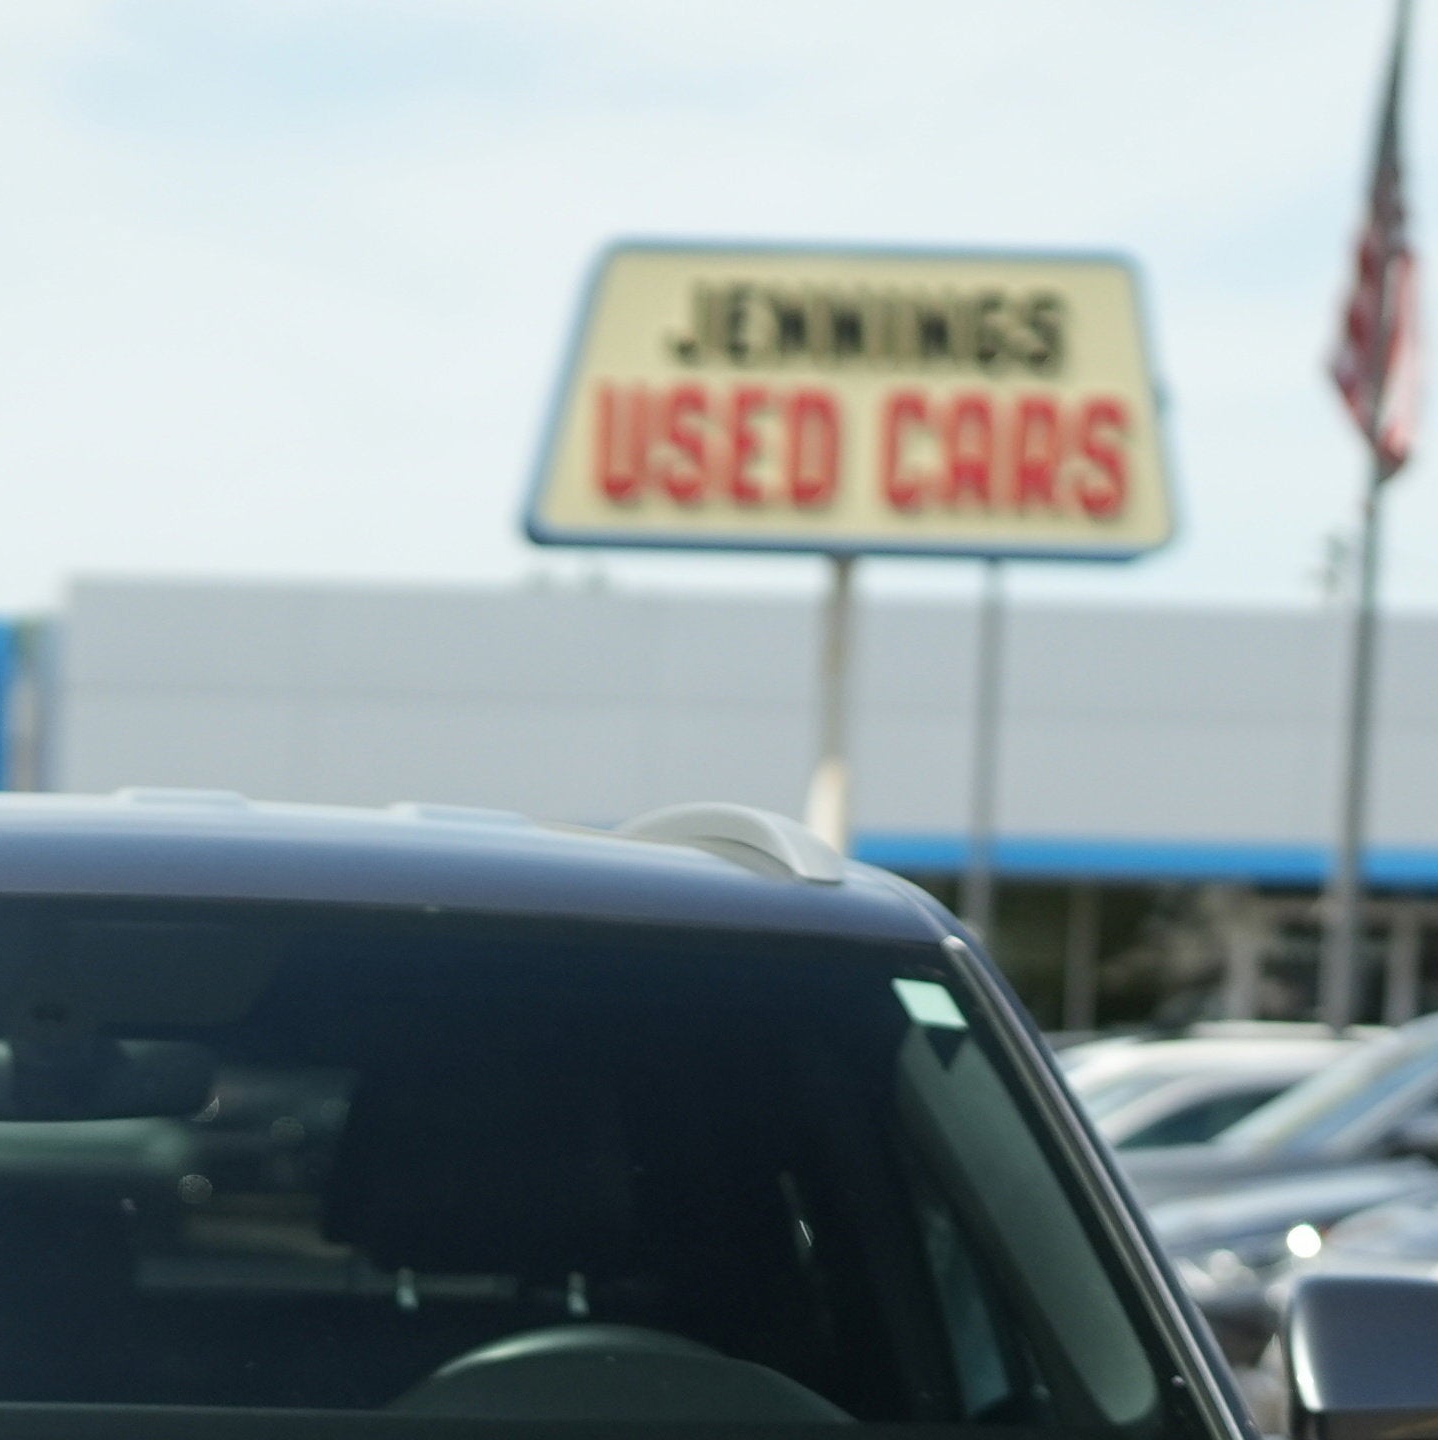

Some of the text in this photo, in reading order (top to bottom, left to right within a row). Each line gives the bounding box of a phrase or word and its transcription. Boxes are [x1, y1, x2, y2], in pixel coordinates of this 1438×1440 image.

[665, 279, 1065, 372] JENNINGS
[596, 384, 1129, 517] USED CARS
